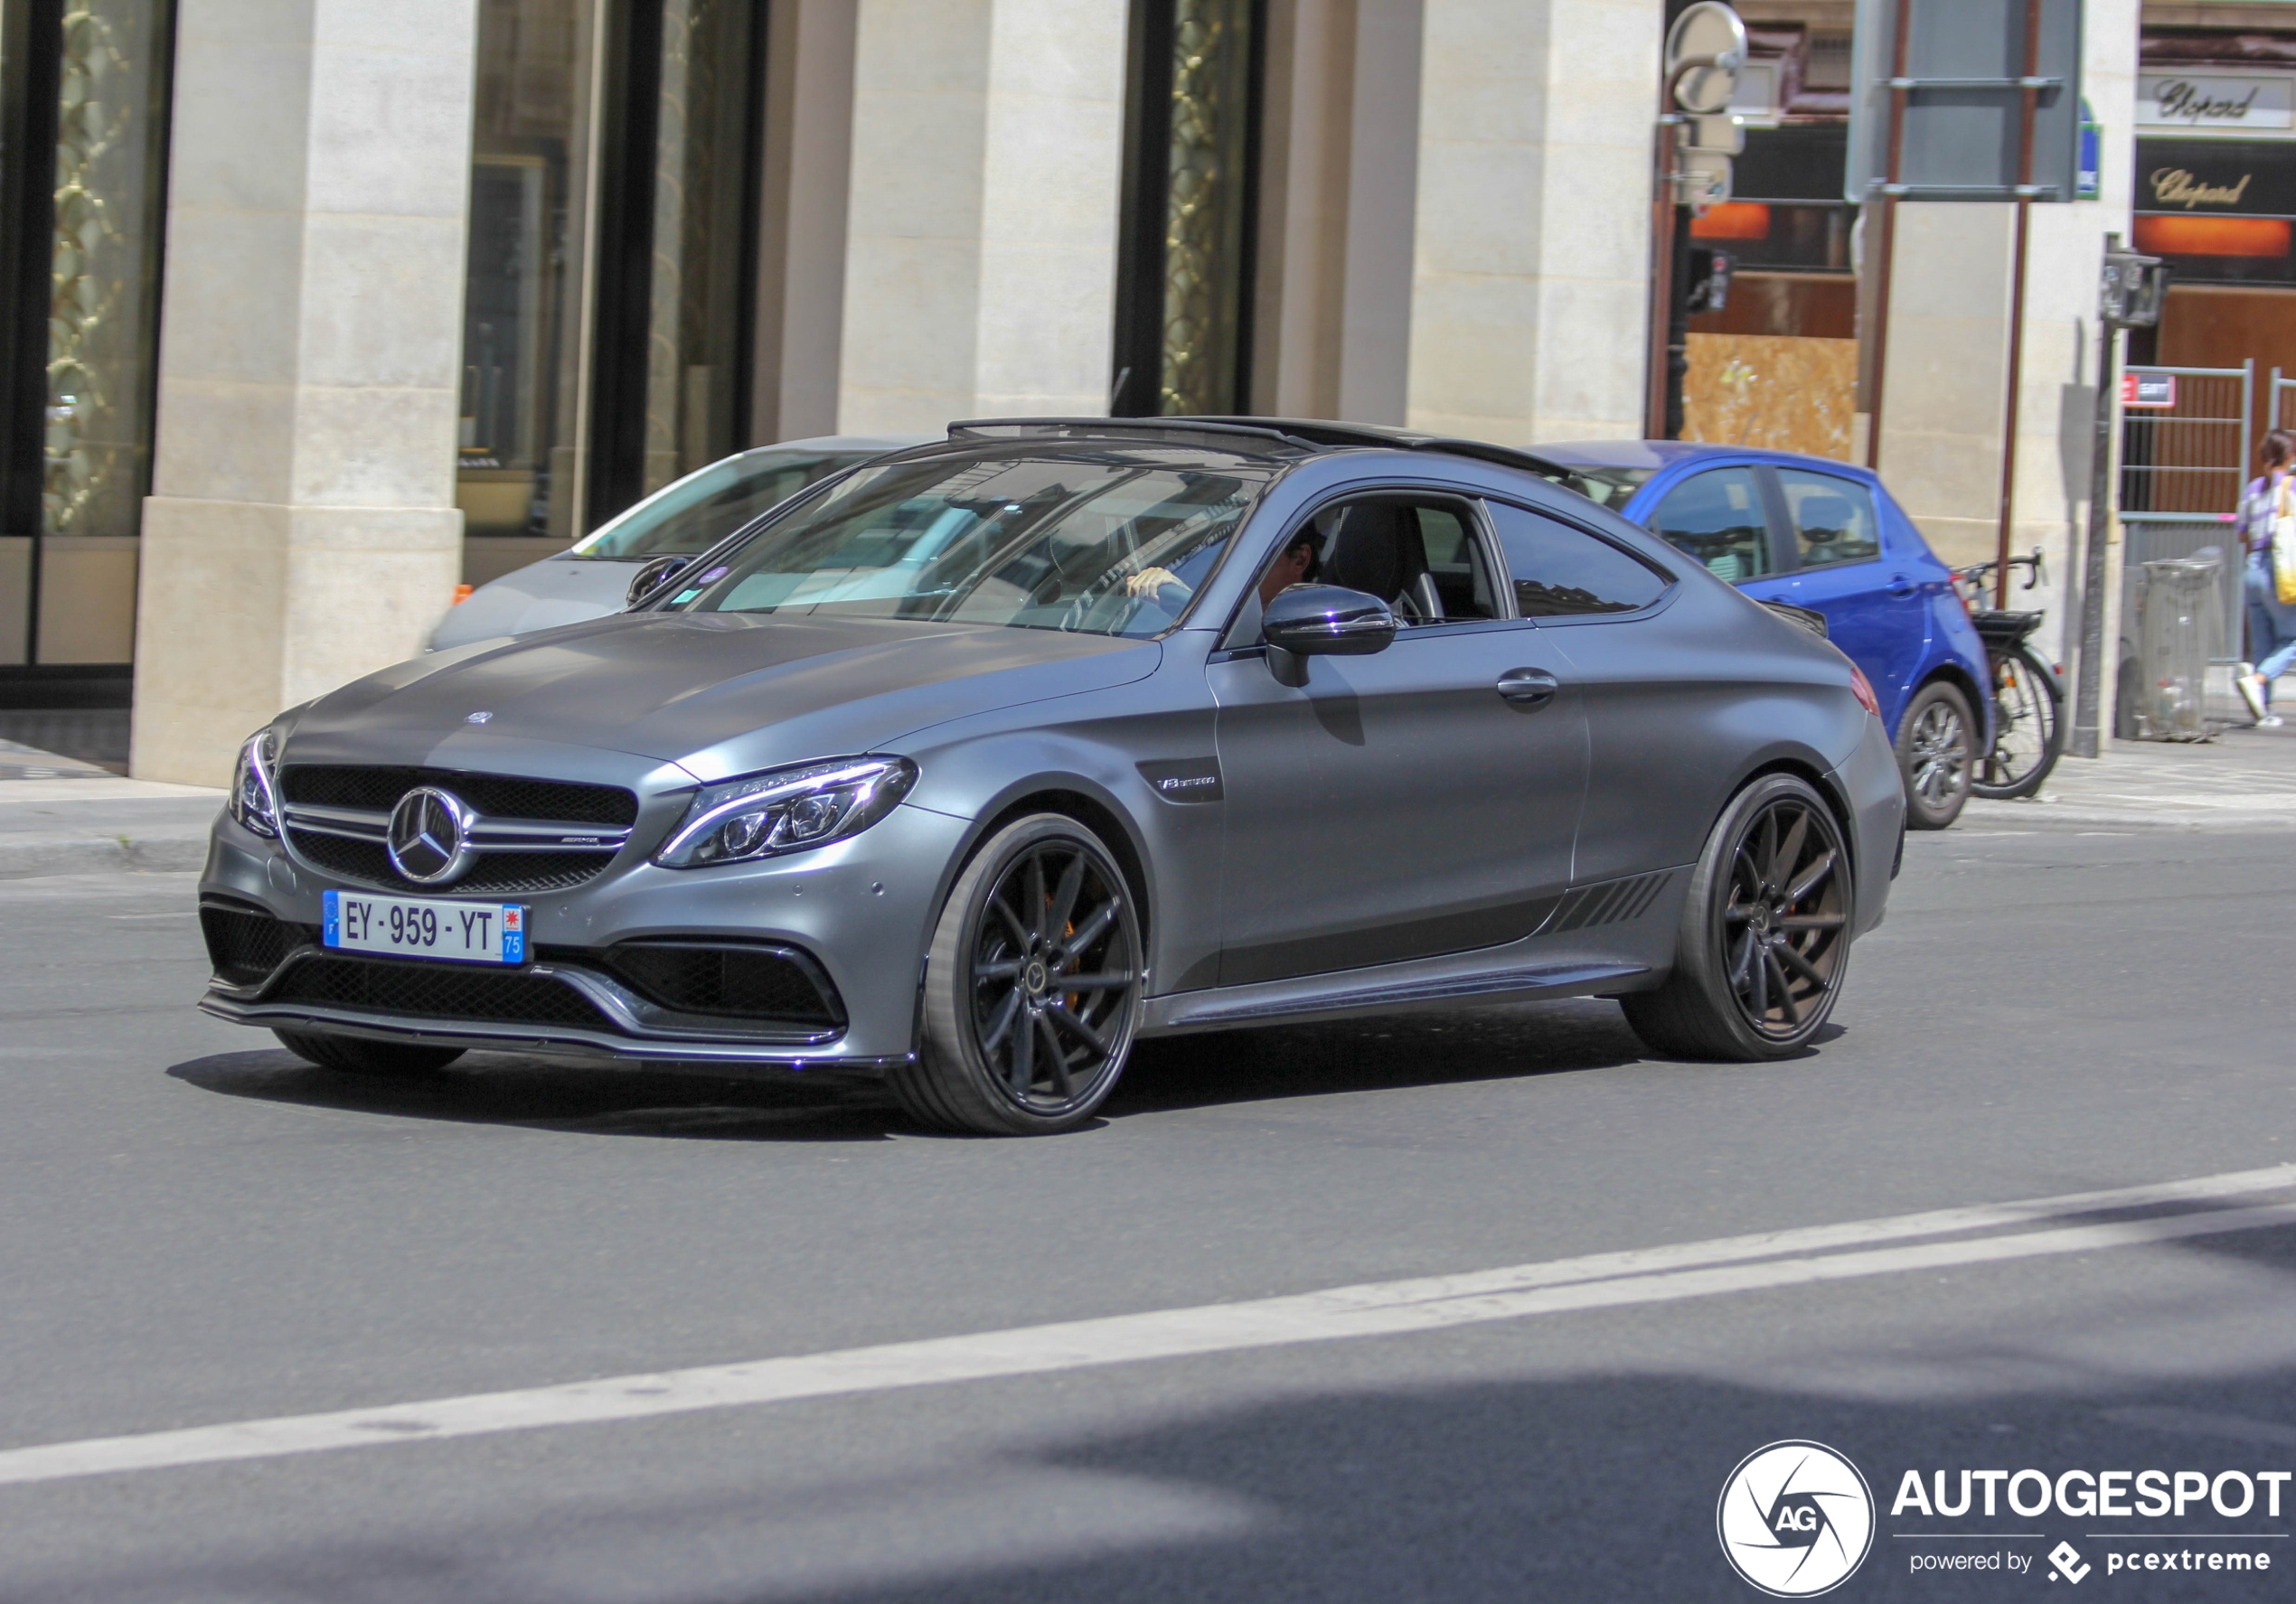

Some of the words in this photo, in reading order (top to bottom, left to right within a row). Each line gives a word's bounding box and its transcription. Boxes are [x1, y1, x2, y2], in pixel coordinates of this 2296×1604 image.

[2153, 79, 2258, 125] Chopard
[2150, 167, 2252, 209] Chopard
[1157, 779, 1178, 790] V8
[328, 924, 334, 935] F
[504, 935, 521, 953] 75
